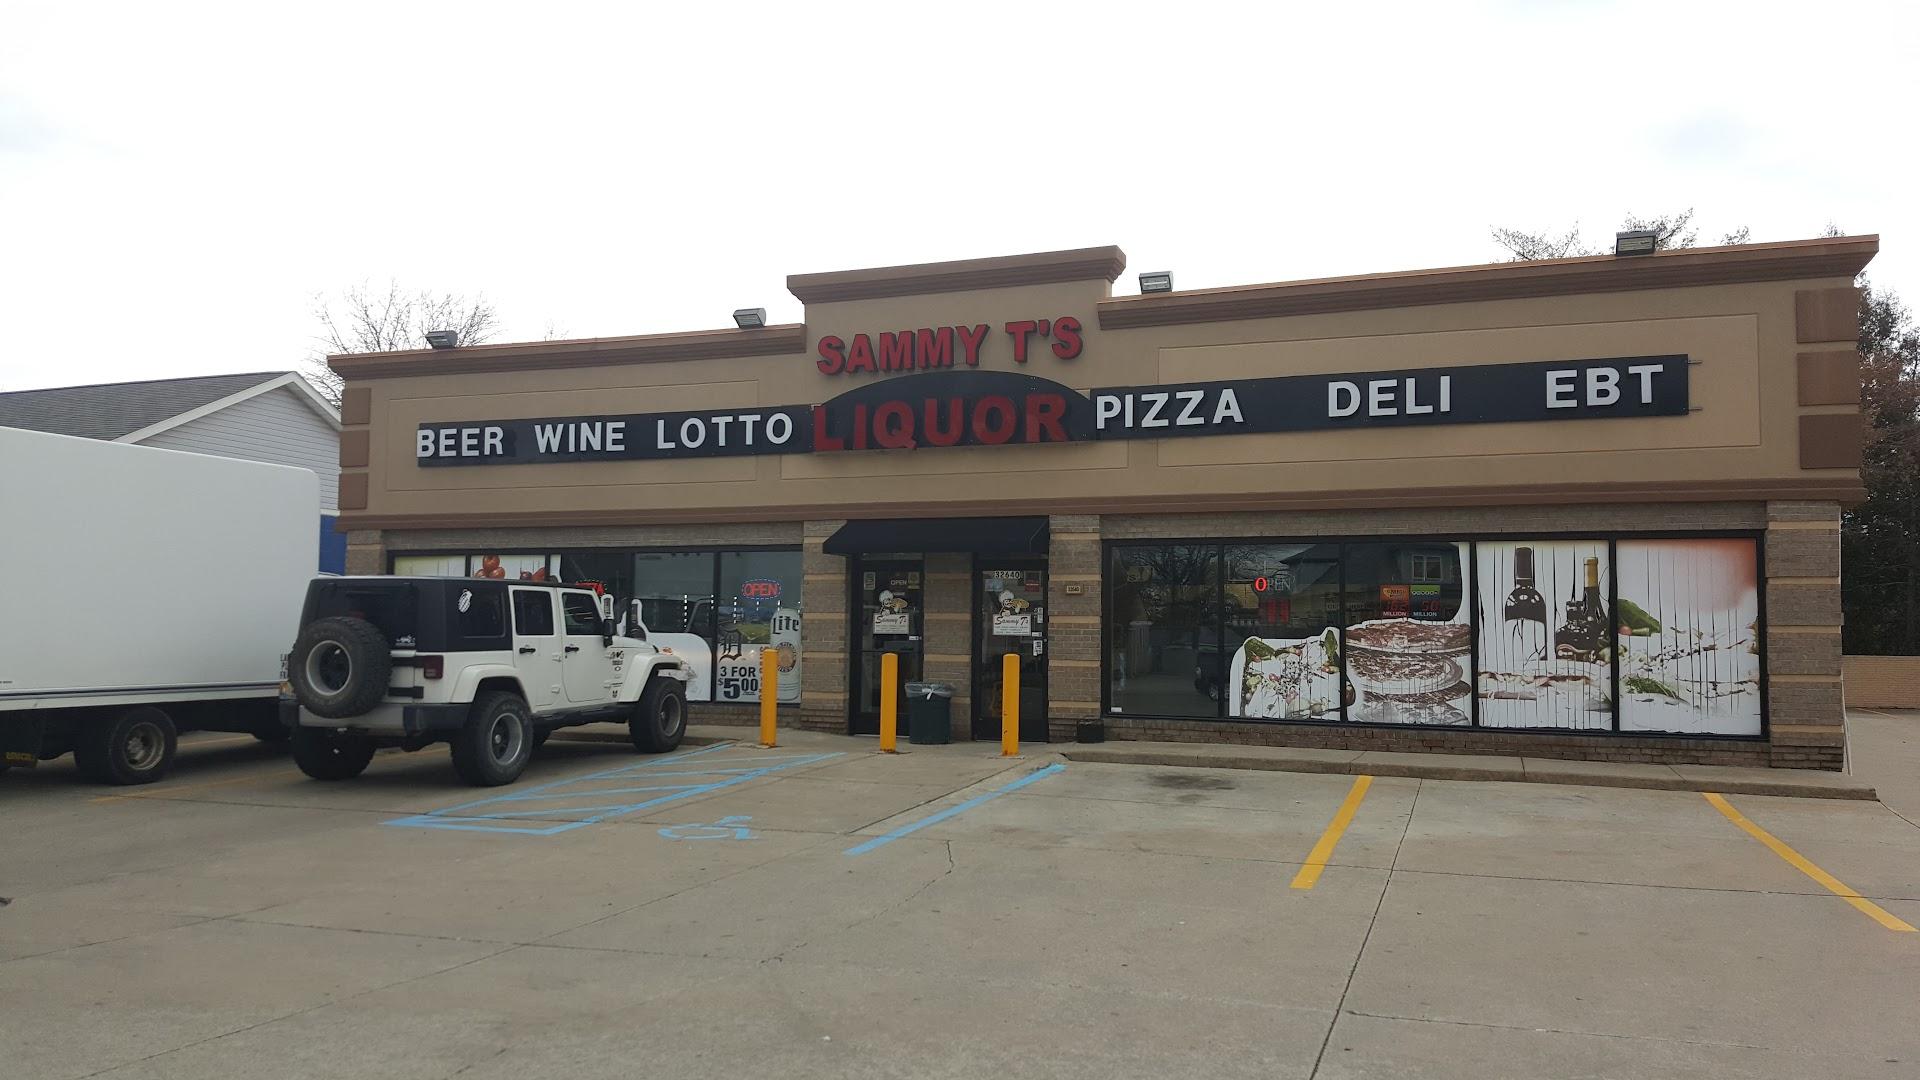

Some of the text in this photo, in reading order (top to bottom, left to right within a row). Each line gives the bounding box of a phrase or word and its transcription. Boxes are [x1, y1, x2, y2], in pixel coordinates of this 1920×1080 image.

[818, 316, 1084, 375] SAMMY T'S
[1096, 364, 1664, 429] PIZZA DELI EBT
[812, 394, 1068, 451] LIQUOR
[416, 412, 793, 458] BEER WINE LOTTO
[994, 570, 1021, 579] 32640
[1254, 577, 1291, 592] OPEN
[745, 583, 779, 597] OPEN
[772, 615, 800, 635] Lite
[720, 666, 756, 677] 3 FOR
